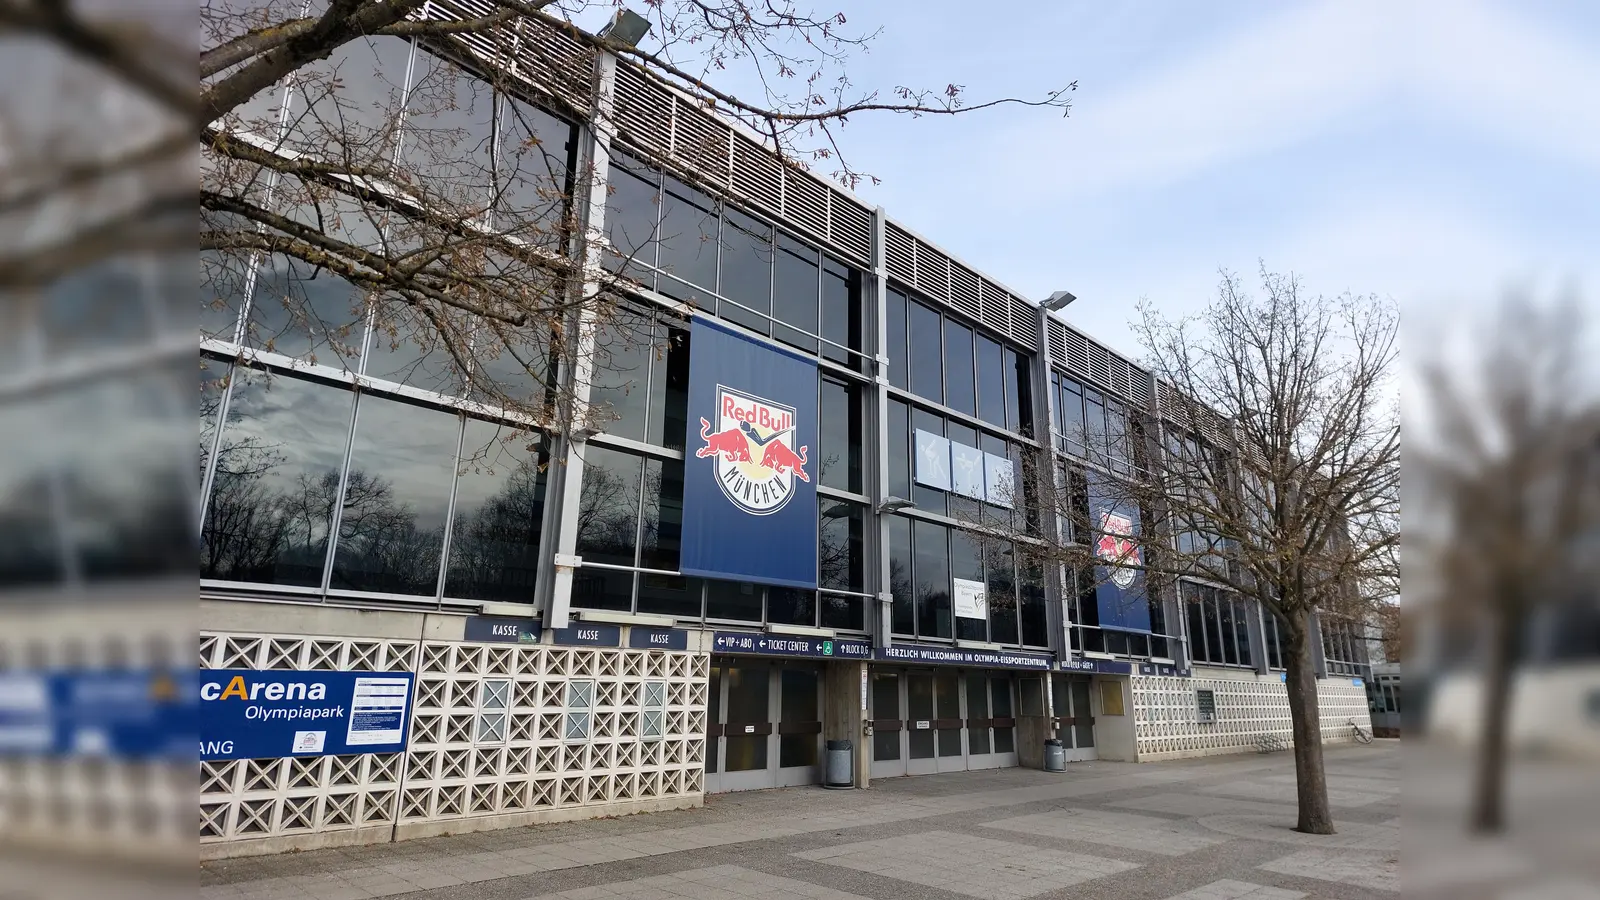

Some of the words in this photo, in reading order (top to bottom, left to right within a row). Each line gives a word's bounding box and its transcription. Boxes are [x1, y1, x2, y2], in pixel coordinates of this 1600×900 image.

[723, 395, 756, 424] Red
[759, 406, 791, 432] Bull
[723, 466, 787, 504] MÜNCHEN
[492, 625, 517, 636] KASSE
[577, 629, 599, 640] KASSE
[650, 634, 669, 644] KASSE
[725, 636, 735, 648] VIP
[740, 638, 752, 649] ABO
[768, 639, 787, 651] TICKET
[788, 641, 809, 652] CENTER
[845, 644, 860, 654] BLOCK
[885, 647, 919, 658] HERZLICH
[920, 650, 963, 661] WILLKOMMEN
[964, 653, 973, 662] IM
[974, 653, 1047, 667] OLYMPIA-EISSPORTZENTRUM
[245, 705, 345, 722] Olympiapark
